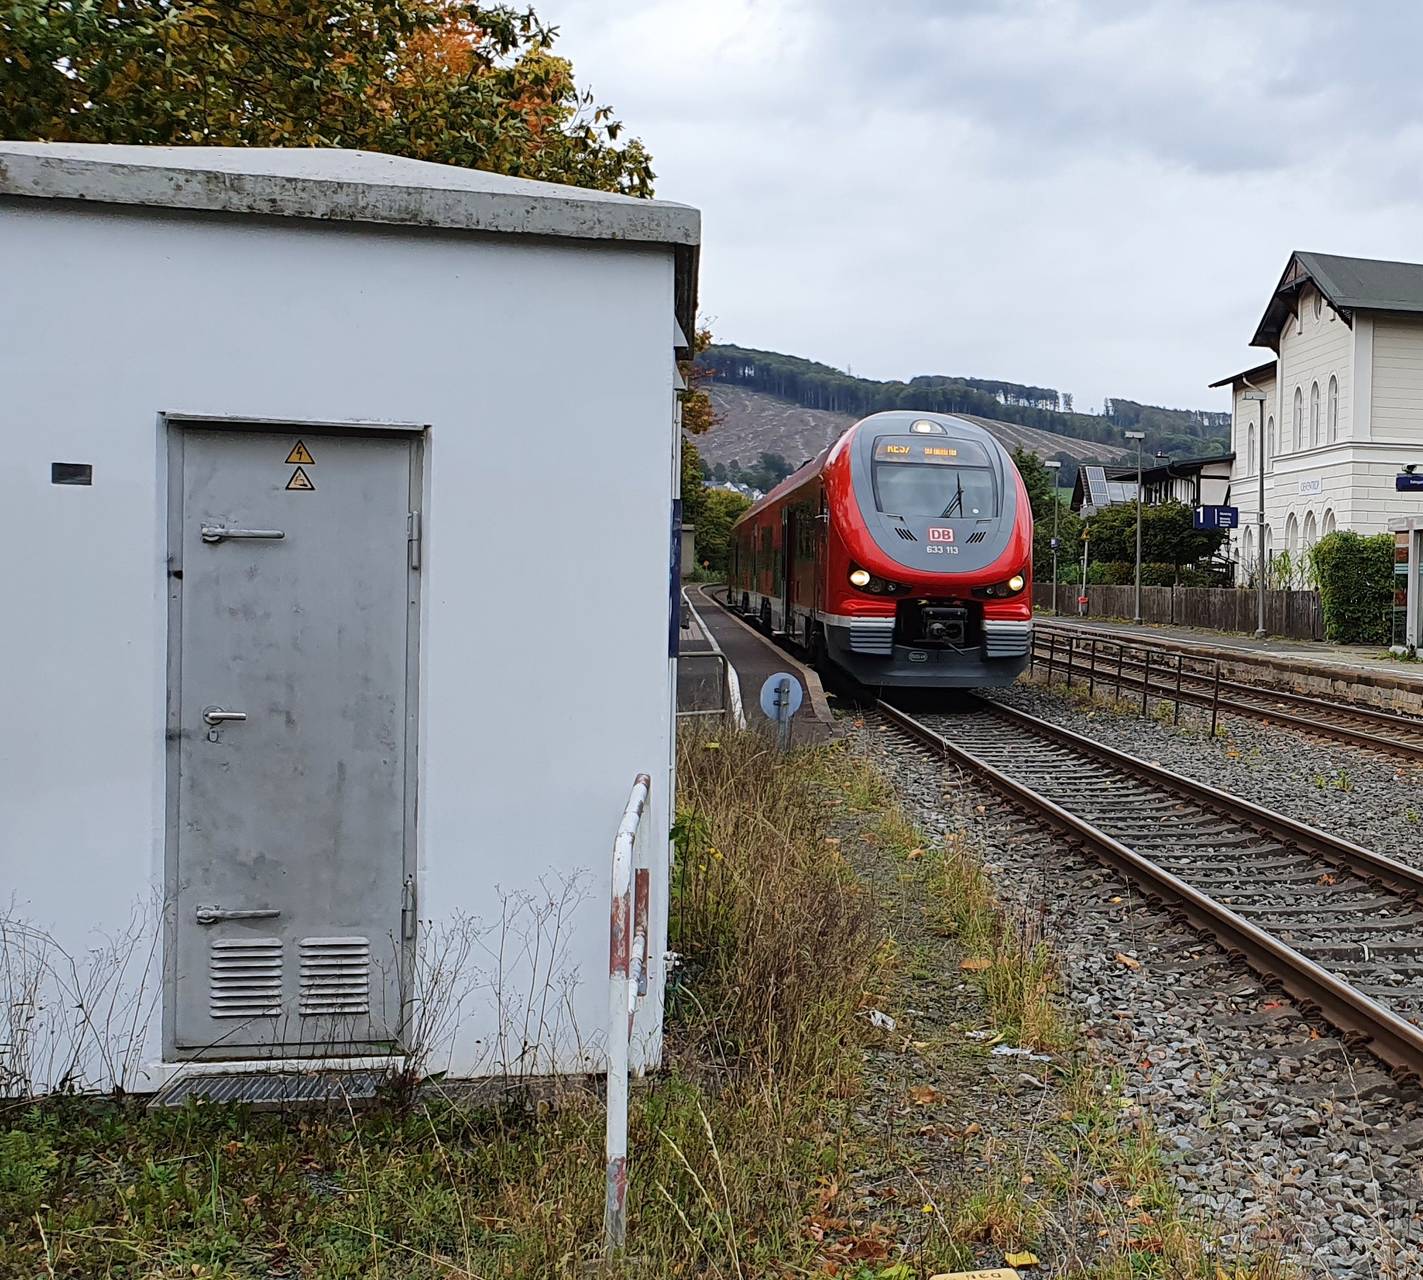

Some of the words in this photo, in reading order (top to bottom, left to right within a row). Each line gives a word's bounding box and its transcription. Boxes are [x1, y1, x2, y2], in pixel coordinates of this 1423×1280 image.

[1196, 506, 1204, 523] 1
[931, 529, 952, 540] DB
[926, 545, 944, 554] 633
[946, 546, 959, 555] 113
